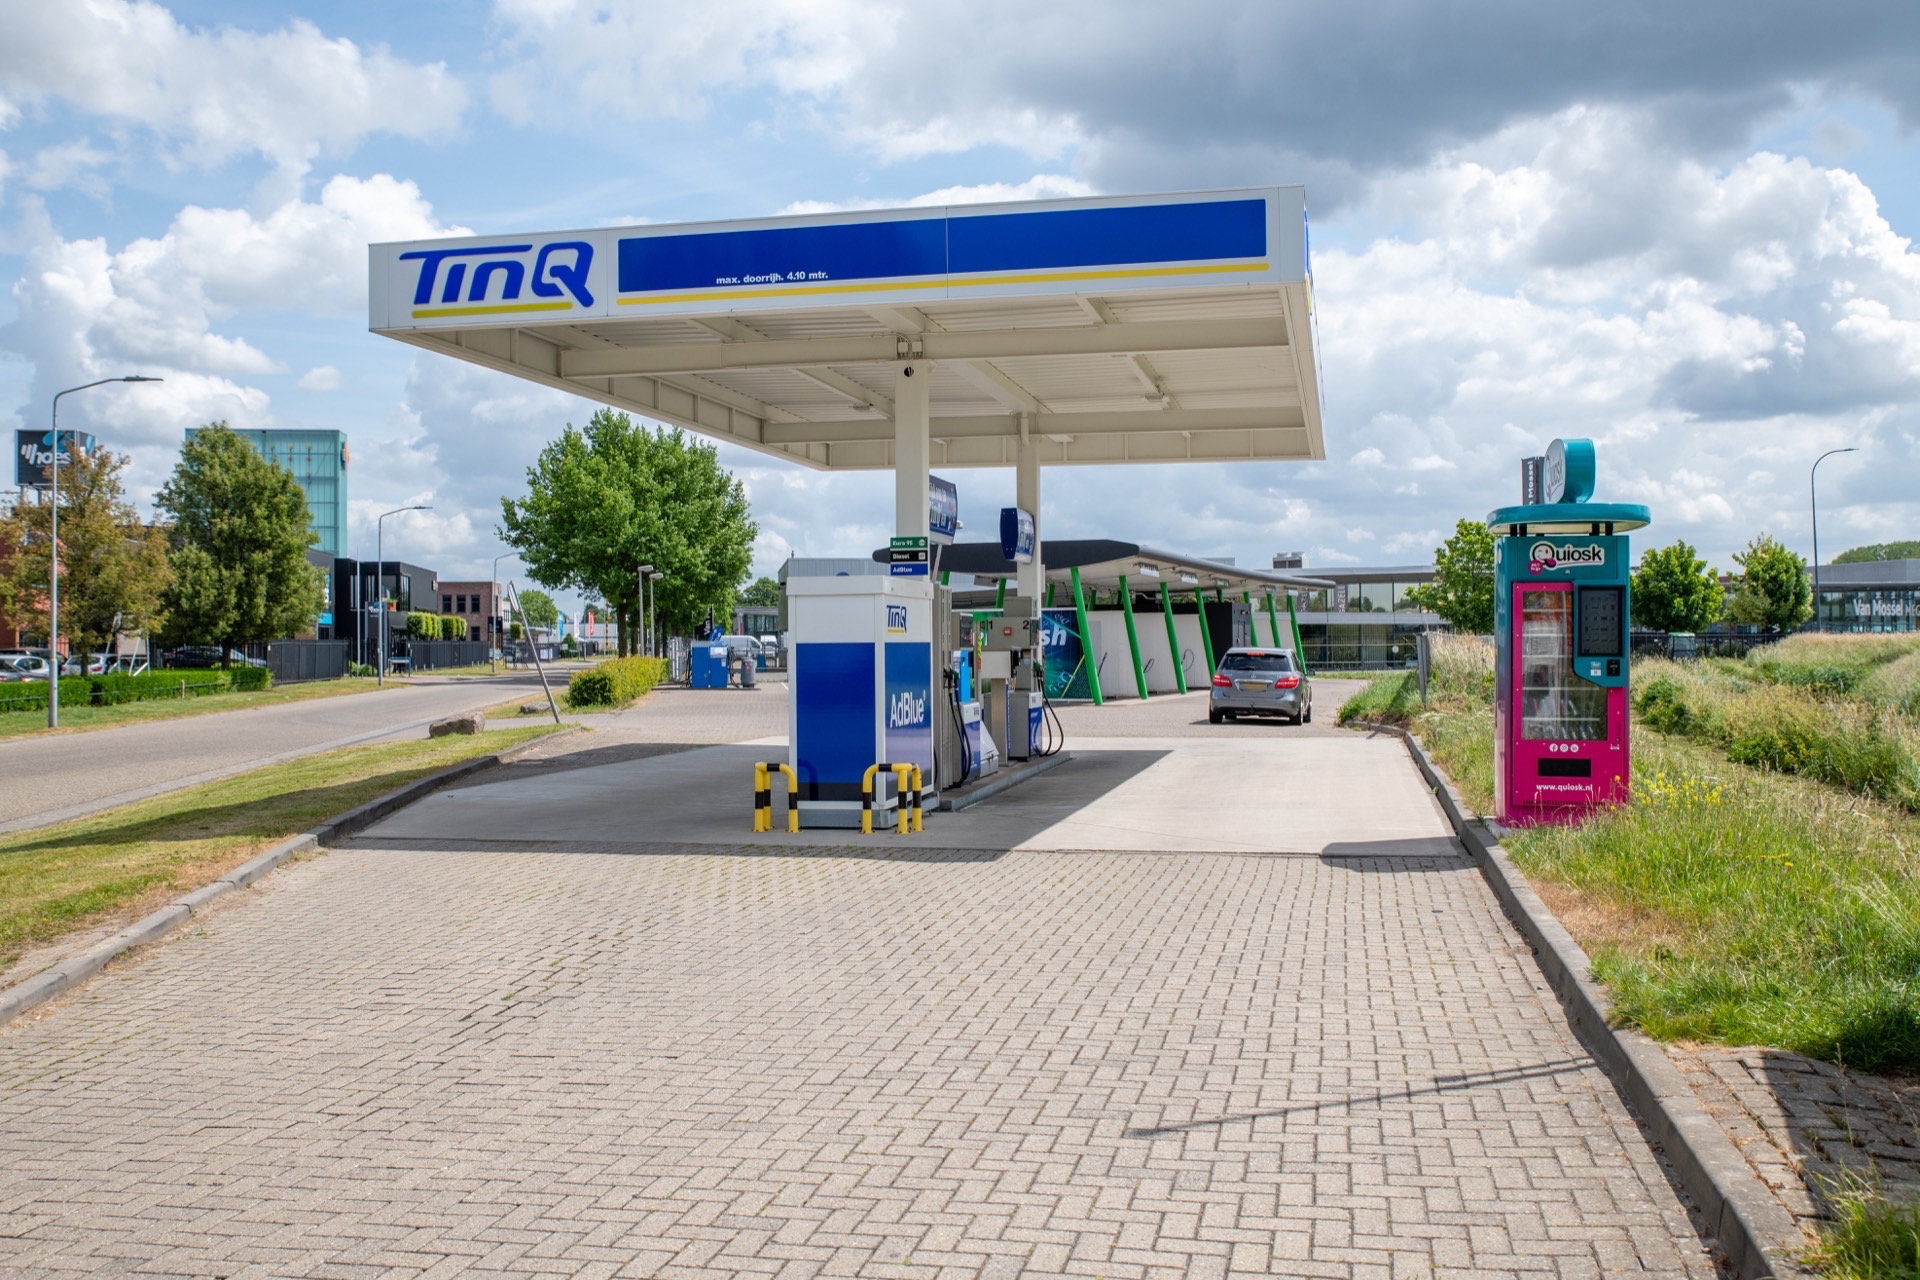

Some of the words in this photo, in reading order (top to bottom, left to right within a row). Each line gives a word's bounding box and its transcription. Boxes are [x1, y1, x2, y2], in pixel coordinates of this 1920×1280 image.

[400, 242, 594, 308] TinQ
[743, 273, 784, 284] doorrijh.
[787, 271, 805, 280] 4.10
[809, 270, 828, 279] mtr.
[1532, 543, 1602, 567] Quiosk
[1853, 599, 1870, 616] Van
[1872, 599, 1904, 616] Mossel
[886, 605, 907, 632] TinQ
[989, 621, 993, 630] 1
[1022, 621, 1029, 630] 2
[1536, 783, 1593, 792] www.quiosk.nl
